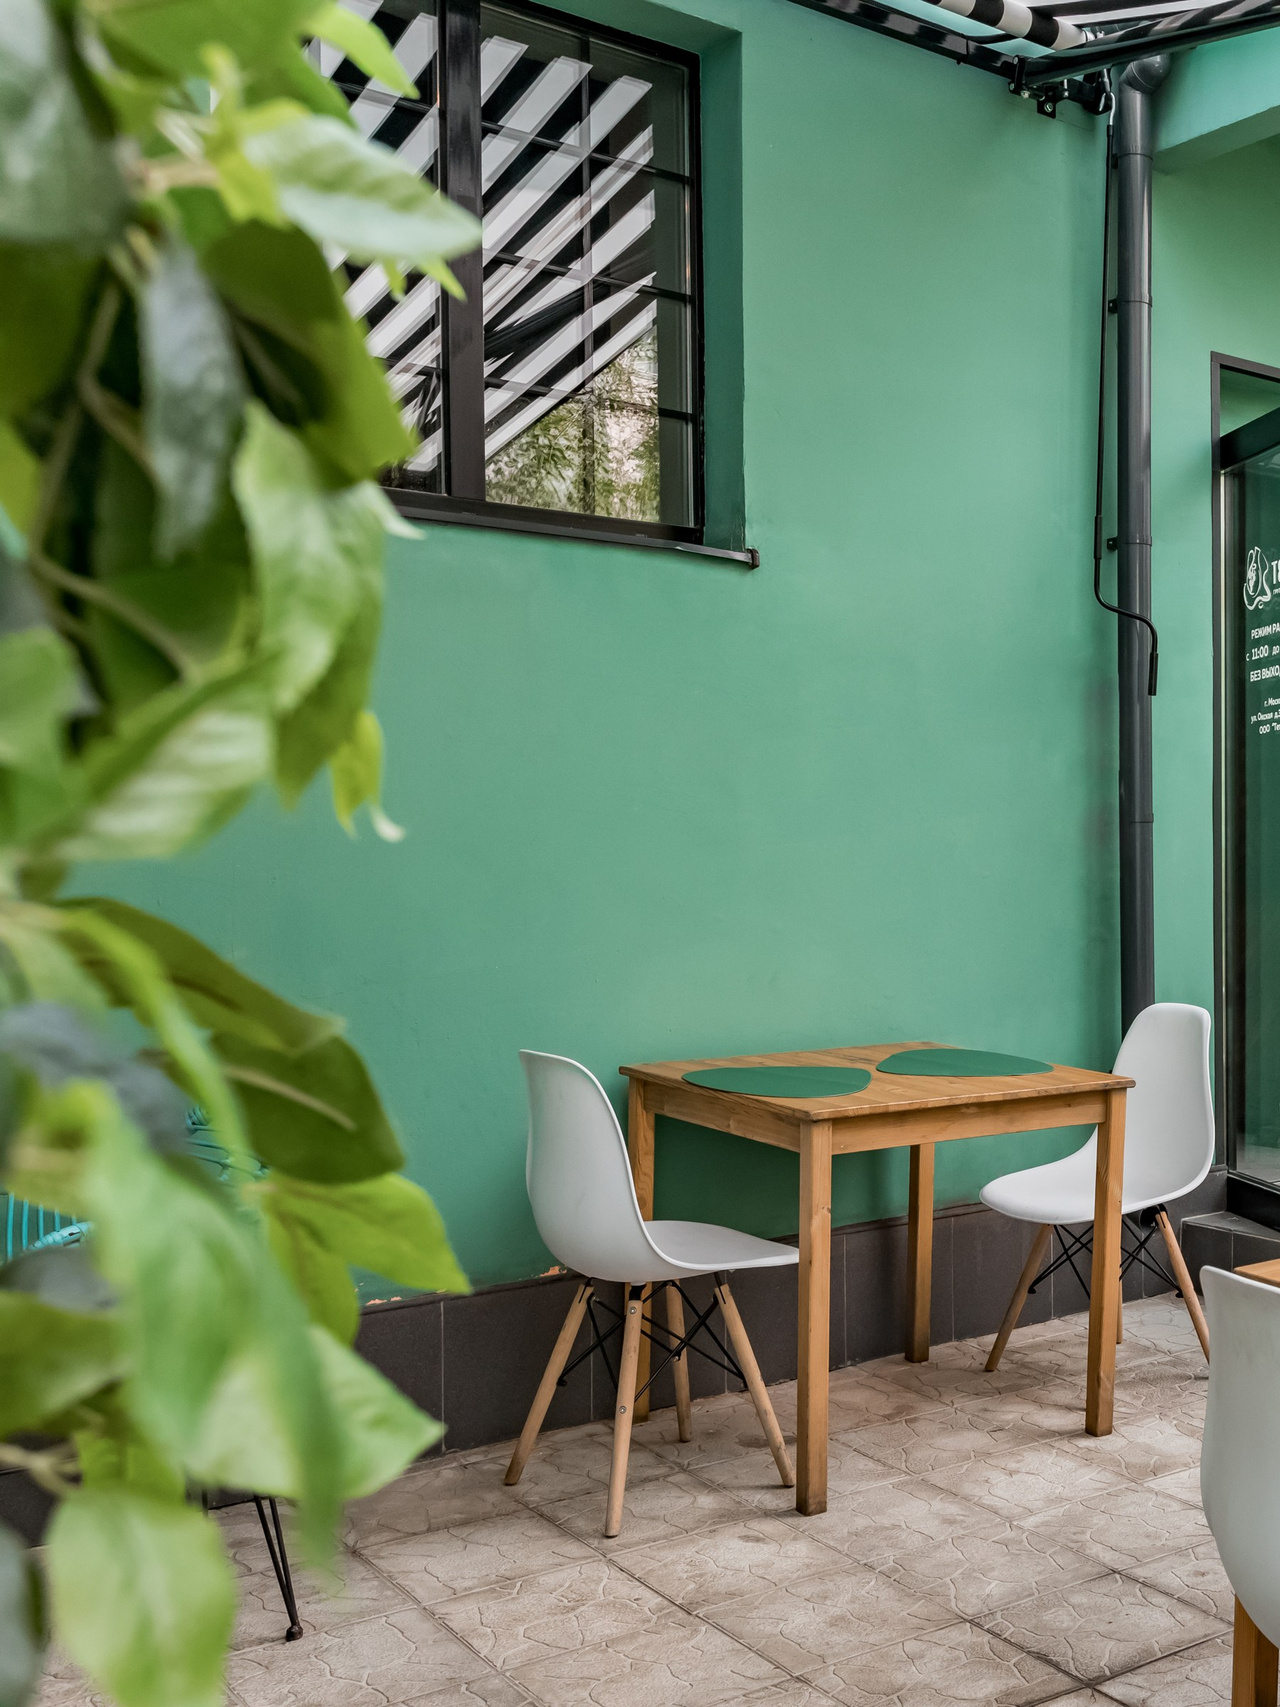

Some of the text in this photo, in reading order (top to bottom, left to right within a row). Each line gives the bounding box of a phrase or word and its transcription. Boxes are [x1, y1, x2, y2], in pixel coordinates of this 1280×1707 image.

[1251, 625, 1272, 640] РЕЖИМ
[1251, 645, 1269, 660] 11:00
[1272, 645, 1280, 656] до
[1250, 669, 1261, 682] БЕЗ
[1259, 724, 1270, 735] ООО
